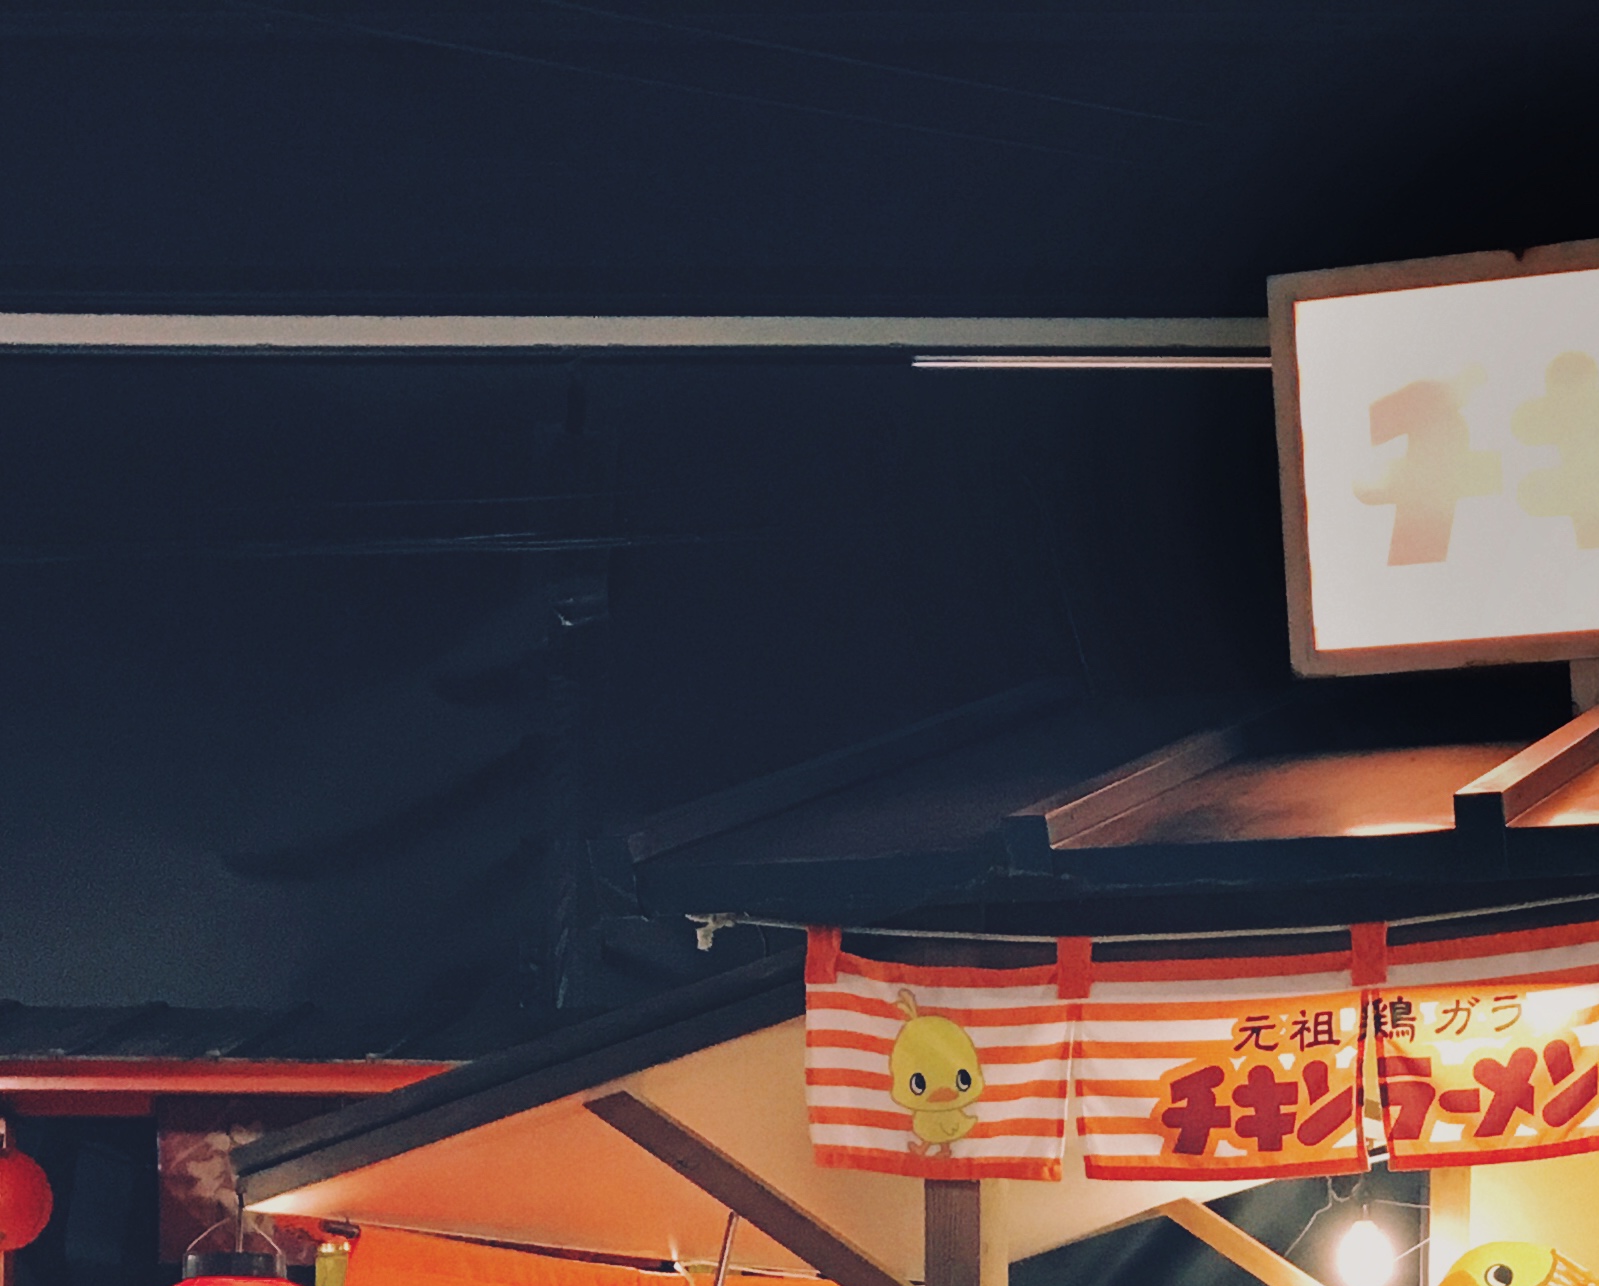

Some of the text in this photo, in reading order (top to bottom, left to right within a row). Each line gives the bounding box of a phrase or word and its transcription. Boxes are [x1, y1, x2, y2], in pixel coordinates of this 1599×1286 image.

[1232, 993, 1524, 1052] 元祖鶏ガラ
[1162, 1039, 1599, 1154] チキンラーメン
